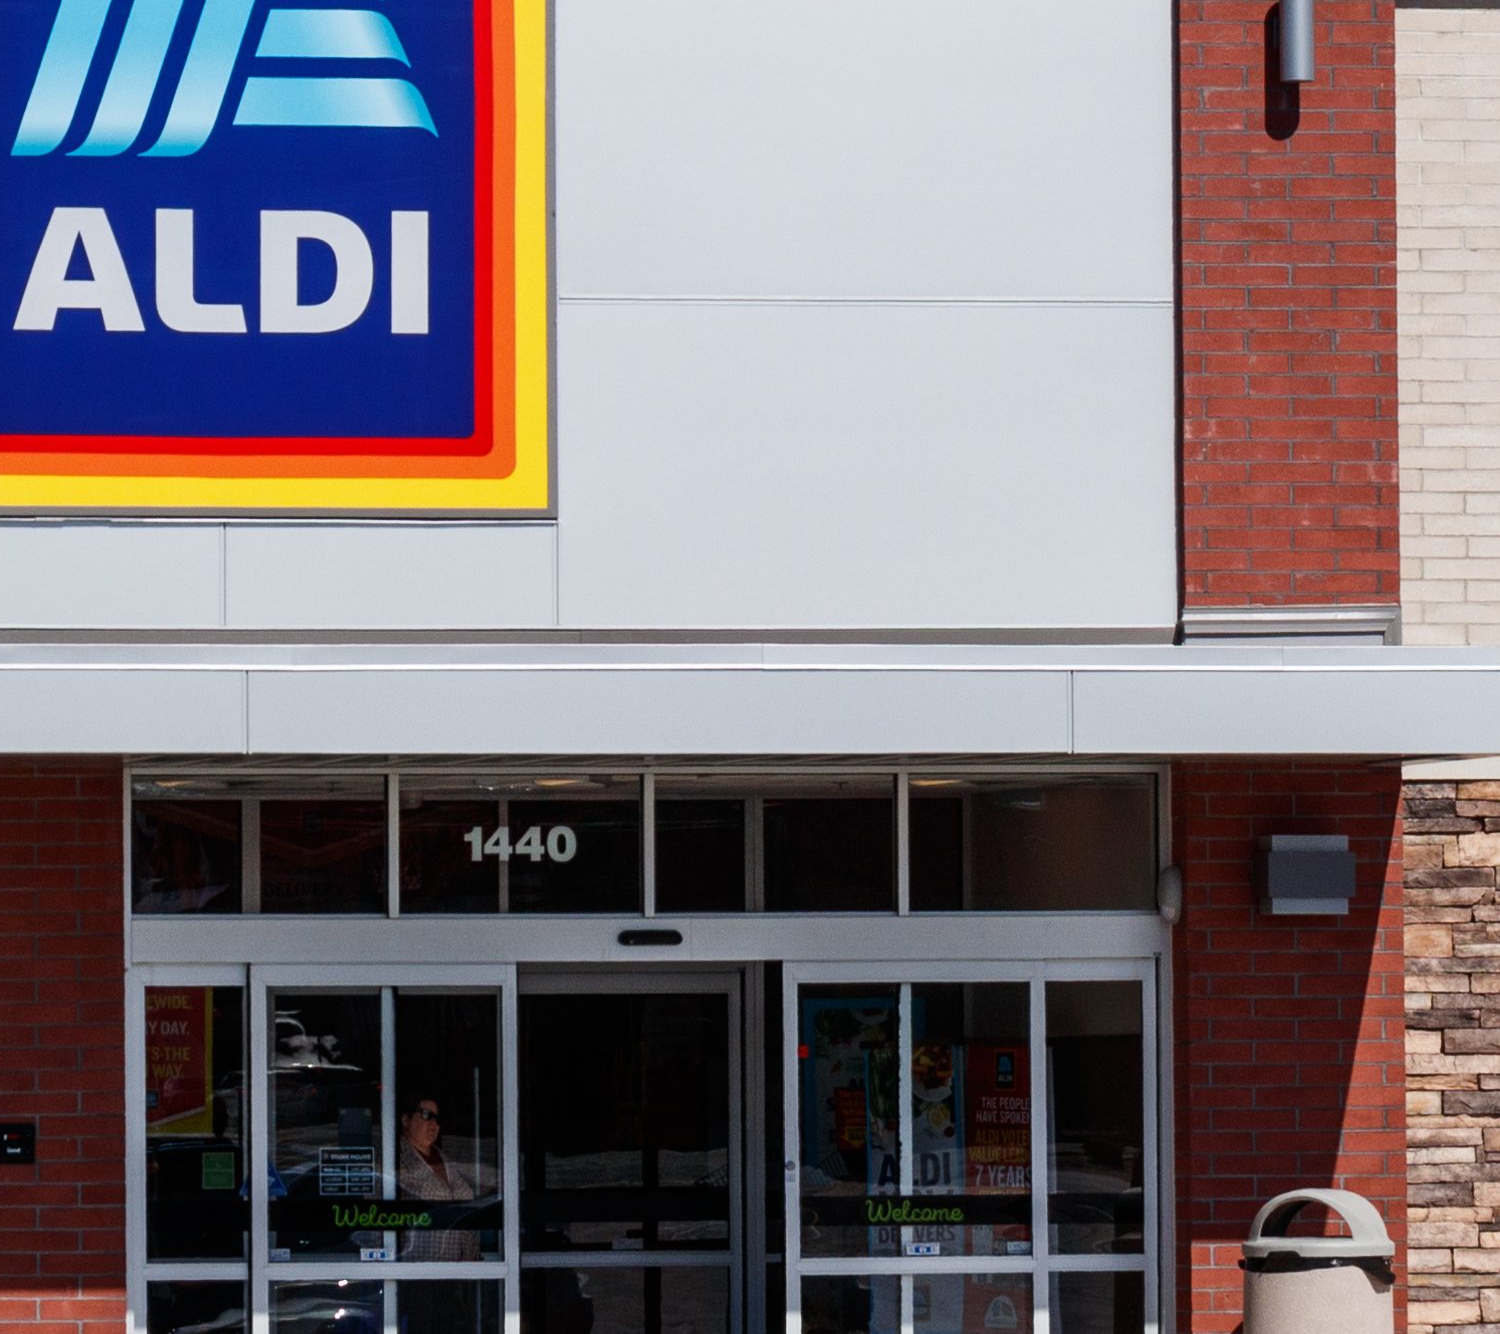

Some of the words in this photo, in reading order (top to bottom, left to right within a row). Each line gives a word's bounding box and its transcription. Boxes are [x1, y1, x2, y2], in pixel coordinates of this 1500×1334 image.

[12, 207, 429, 335] ALDI
[464, 825, 578, 863] 1440
[160, 1020, 190, 1035] DAY.
[981, 1097, 997, 1110] THE
[975, 1110, 998, 1123] HAVE
[975, 1129, 999, 1145] ALDI
[968, 1145, 1001, 1163] VALUE
[878, 1152, 951, 1185] ADI
[975, 1164, 984, 1187] 7
[332, 1204, 432, 1228] Welcome
[865, 1198, 964, 1223] Welcome
